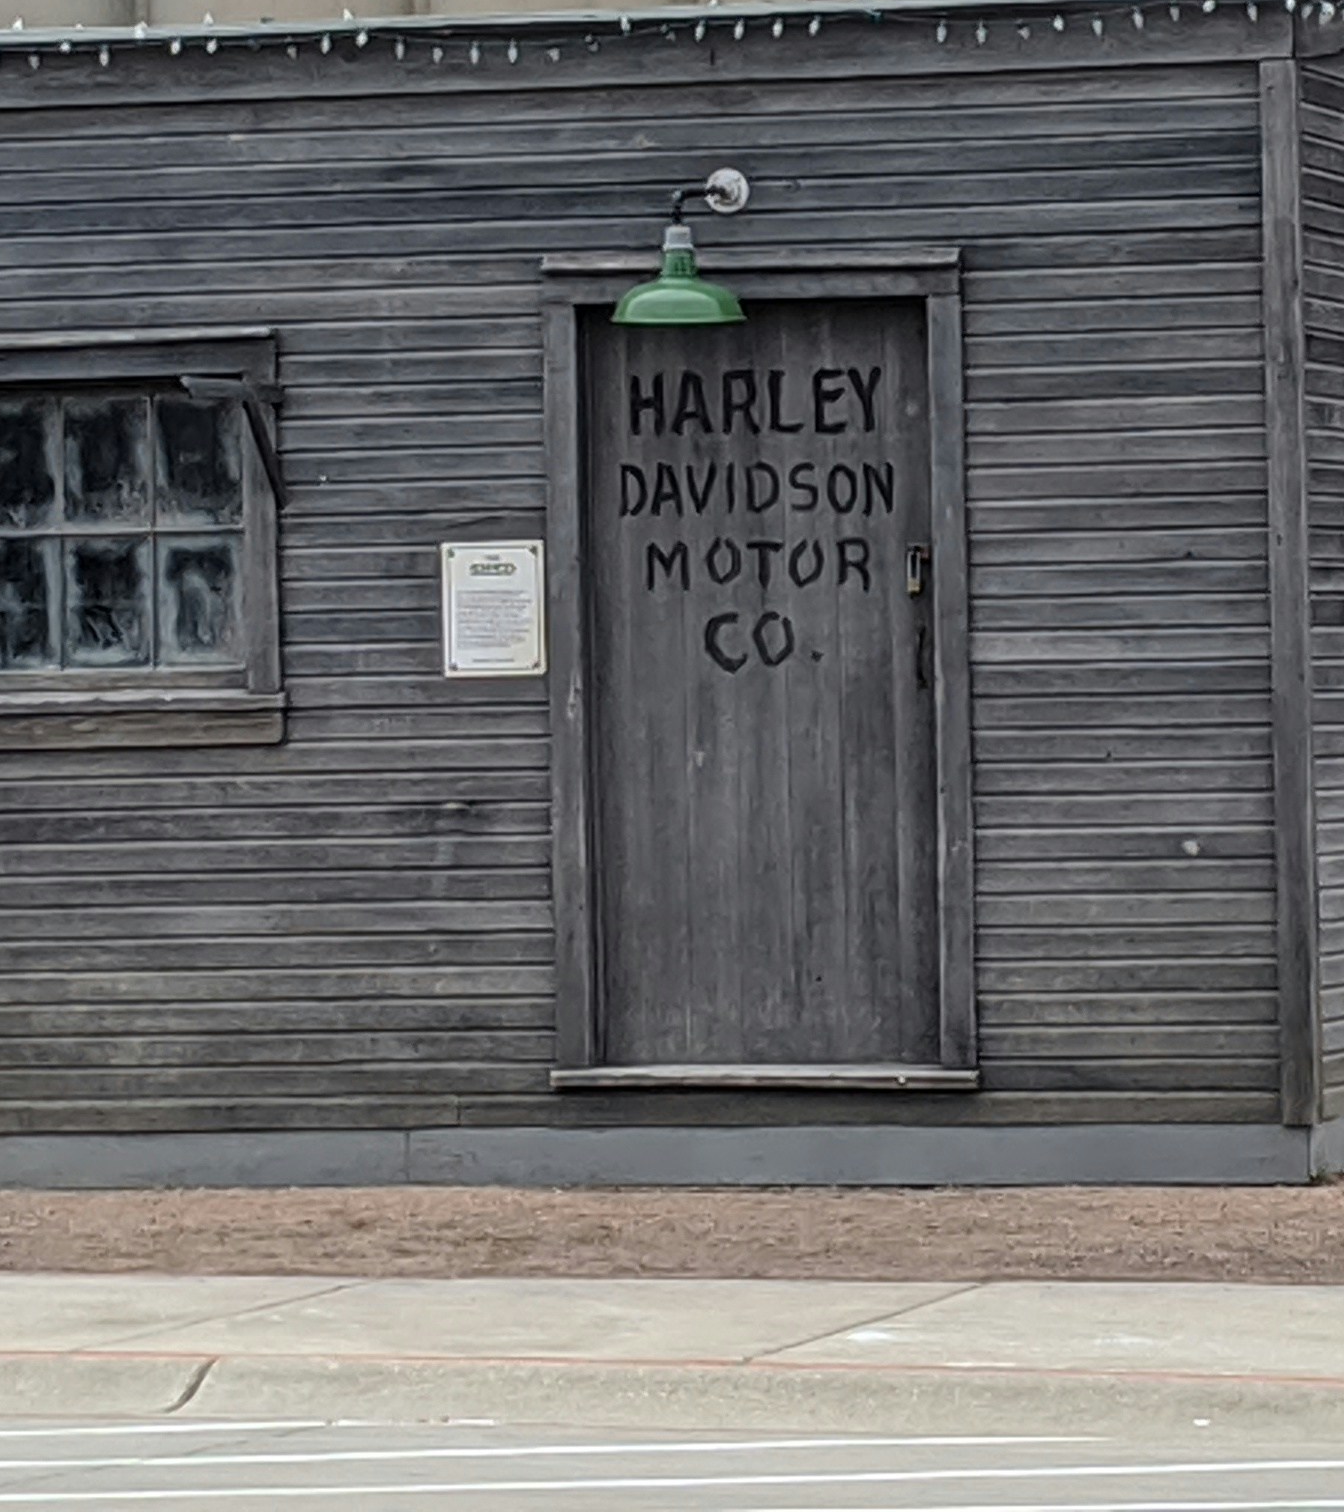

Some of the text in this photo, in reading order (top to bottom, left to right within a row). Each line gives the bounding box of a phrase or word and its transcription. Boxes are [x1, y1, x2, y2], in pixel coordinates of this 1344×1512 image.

[629, 366, 882, 436] HARLEY
[619, 461, 895, 518] DAVIDSON
[646, 536, 872, 593] MOTOR
[704, 610, 824, 675] CO.
